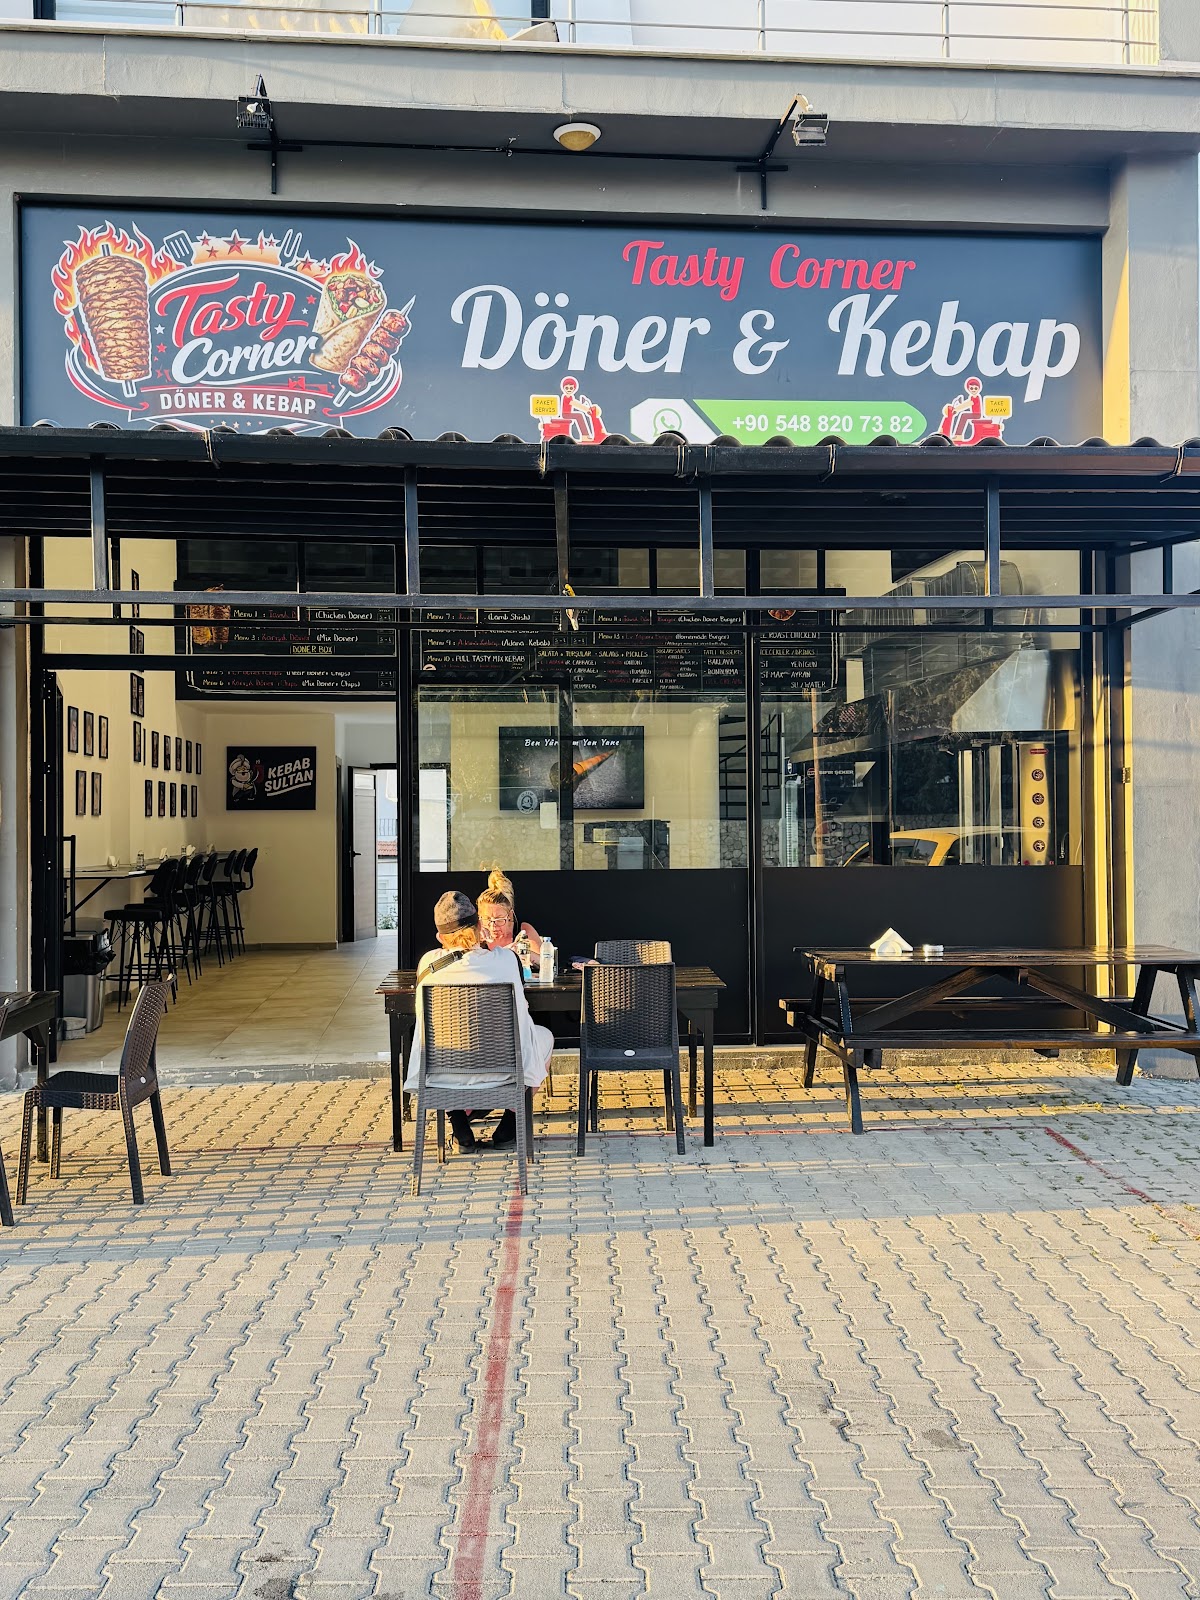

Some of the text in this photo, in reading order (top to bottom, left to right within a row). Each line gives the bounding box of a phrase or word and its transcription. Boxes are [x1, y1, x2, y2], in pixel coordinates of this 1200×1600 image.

[622, 240, 916, 301] Tasty Corner
[155, 272, 309, 347] Tasty
[450, 284, 1081, 403] Döner & Kebap
[171, 335, 319, 384] Corner
[160, 389, 317, 415] DÖNER & KEBAP
[732, 415, 913, 433] +90 548 820 73 82
[234, 610, 252, 618] Menu
[264, 770, 314, 792] SULTAN
[268, 758, 310, 779] KEBAB
